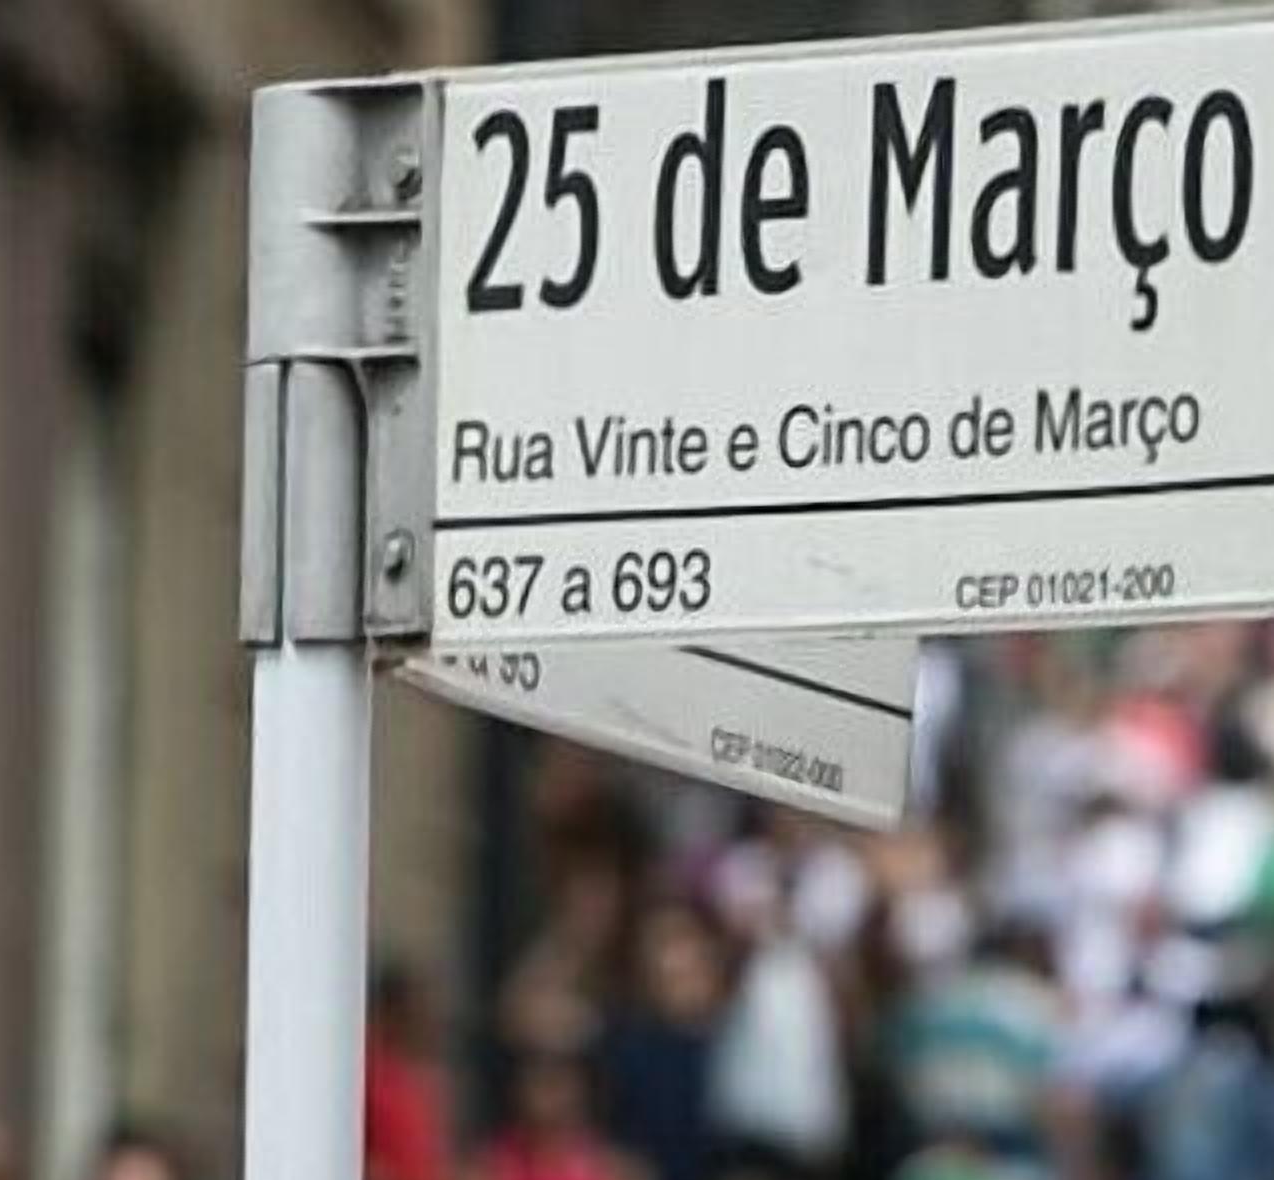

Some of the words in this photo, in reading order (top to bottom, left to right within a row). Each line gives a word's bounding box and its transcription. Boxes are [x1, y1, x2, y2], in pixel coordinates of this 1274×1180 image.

[466, 105, 599, 314] 25
[654, 78, 809, 300] de
[866, 77, 1253, 332] Março
[453, 421, 553, 482] Rua
[576, 416, 707, 477] Vinte
[728, 424, 758, 471] e
[779, 404, 930, 468] Cinco
[949, 396, 1014, 459] de
[1035, 388, 1199, 464] Março
[448, 556, 544, 619] 637
[561, 566, 591, 614] a
[612, 549, 710, 612] 693
[956, 575, 1019, 608] CEP
[1027, 563, 1175, 607] 01021-200
[711, 726, 750, 763] CEP
